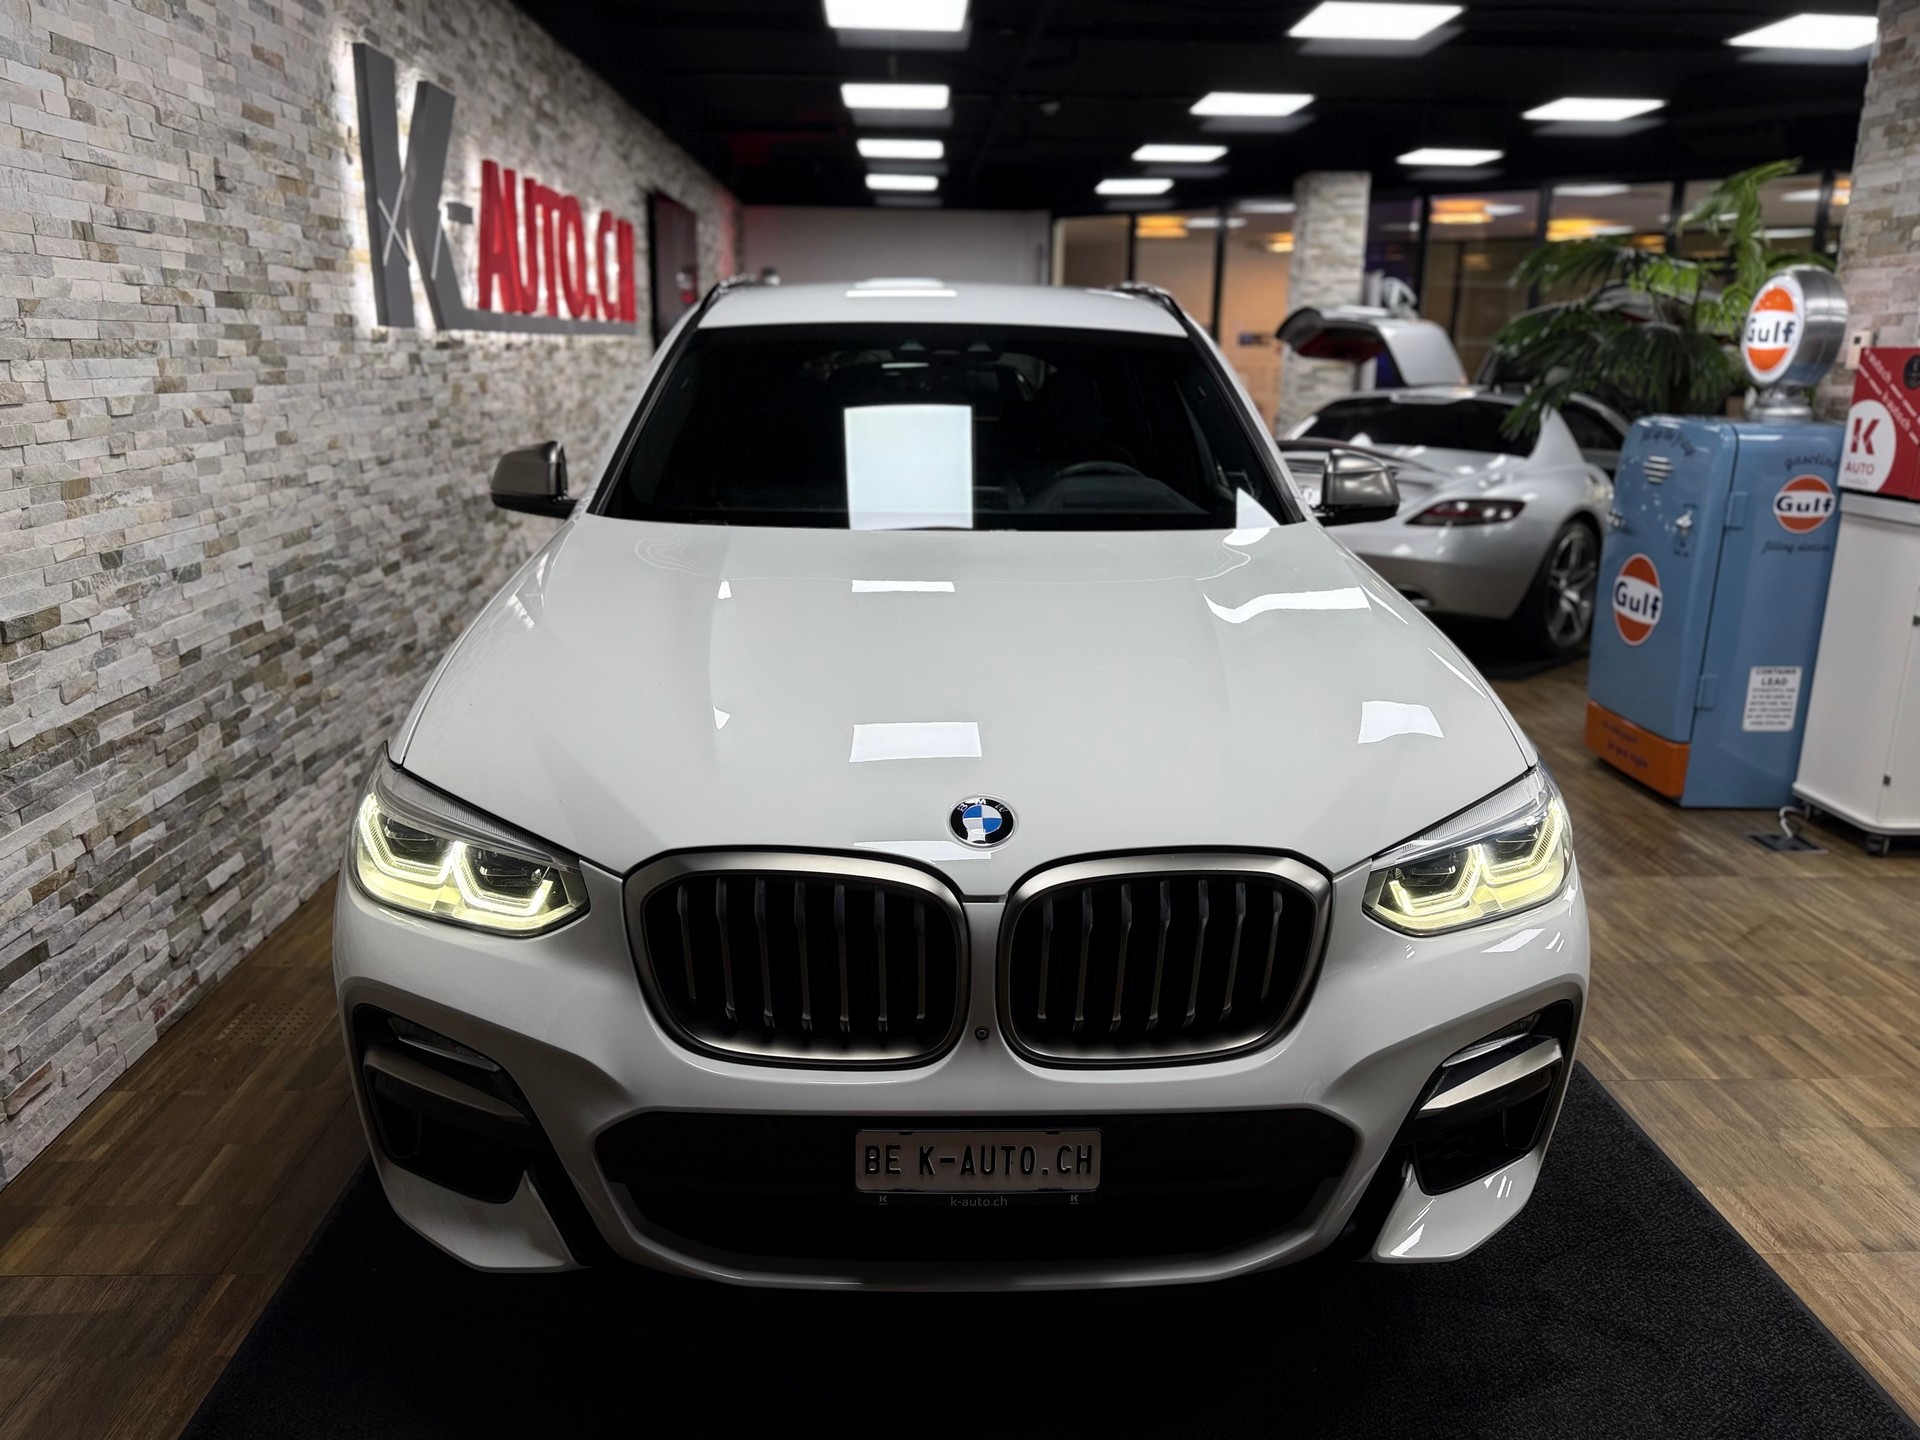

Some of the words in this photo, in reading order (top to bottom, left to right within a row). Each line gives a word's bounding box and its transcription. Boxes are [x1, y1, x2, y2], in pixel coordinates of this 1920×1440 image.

[1850, 418, 1880, 455] K
[1845, 462, 1876, 476] AUTO
[1776, 496, 1832, 512] Gulf
[1615, 581, 1660, 619] Gulf
[957, 798, 1008, 812] BMW
[865, 1145, 901, 1175] BE
[919, 1145, 1093, 1175] K-AUTO.CH
[951, 1195, 1008, 1207] k-auto.ch
